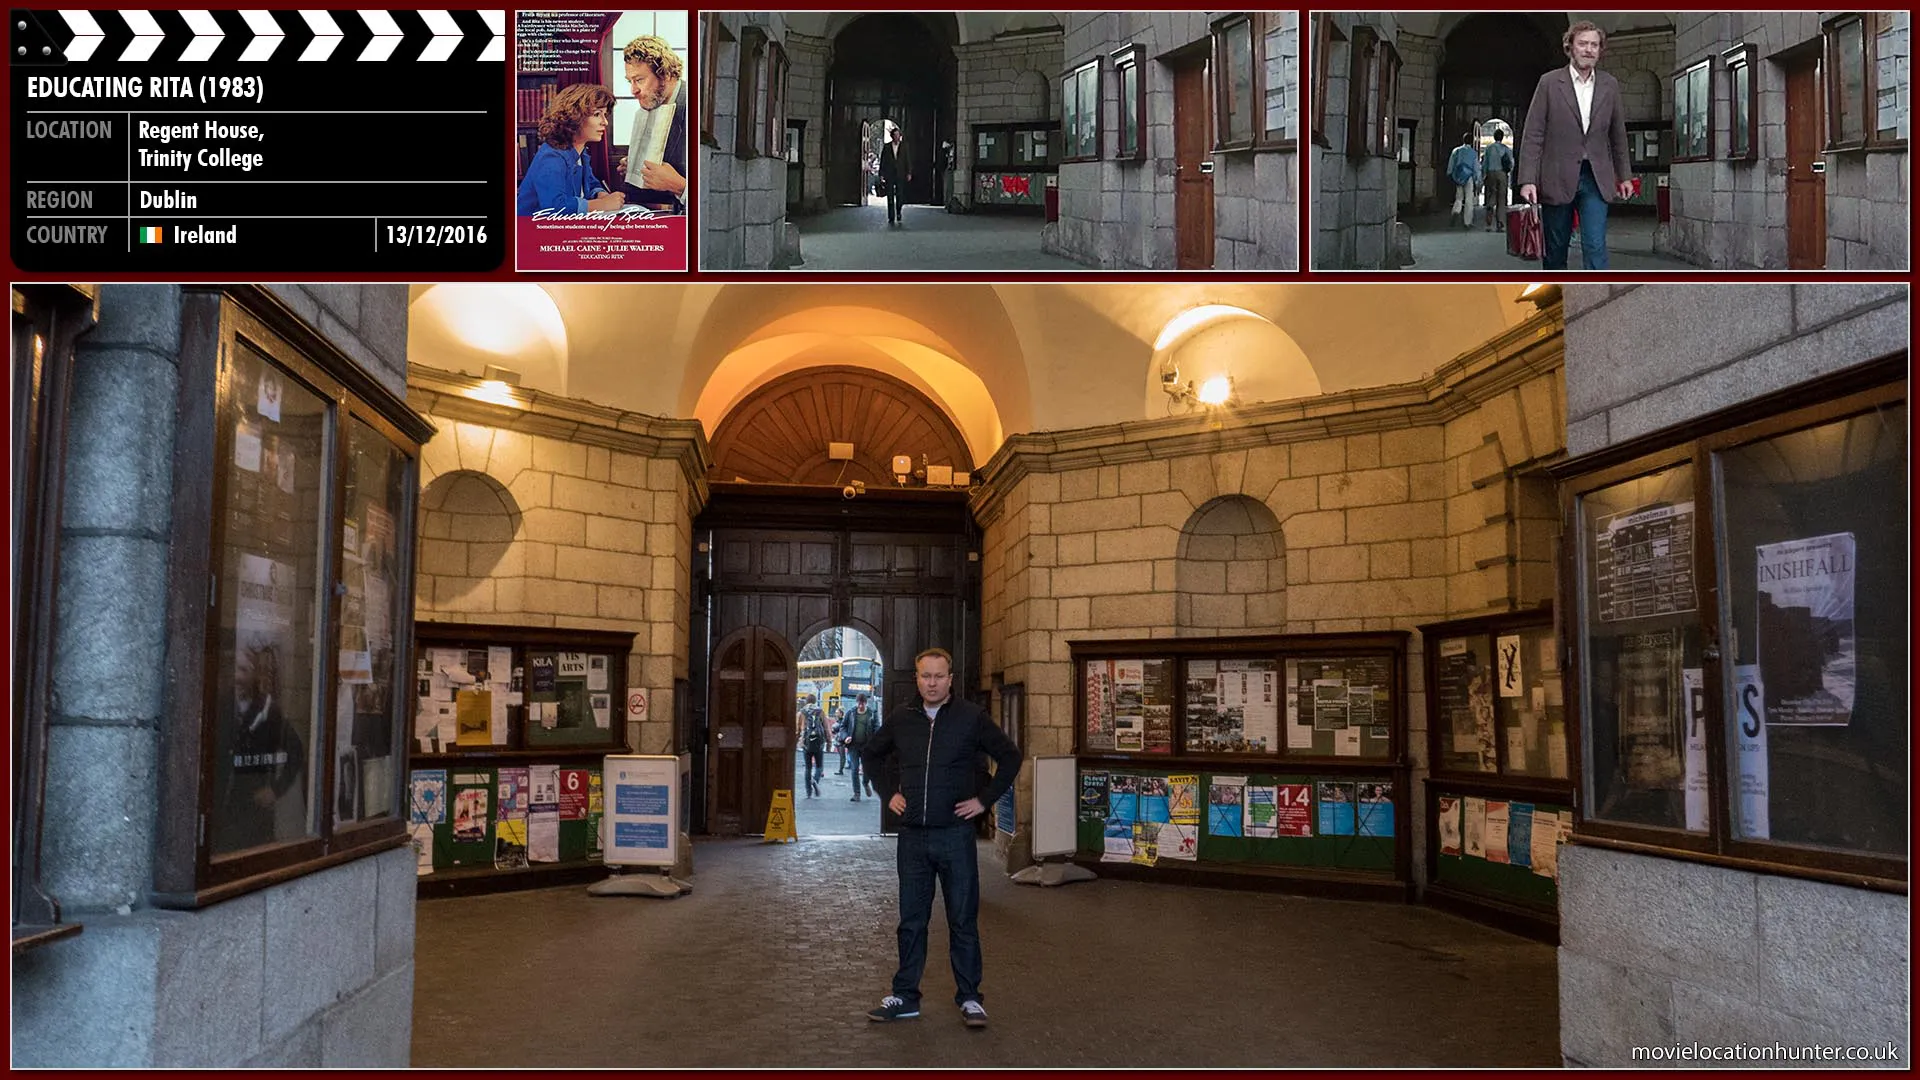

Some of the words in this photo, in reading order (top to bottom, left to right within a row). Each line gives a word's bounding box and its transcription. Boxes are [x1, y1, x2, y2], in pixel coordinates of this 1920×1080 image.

[531, 207, 616, 232] Educating
[618, 206, 672, 224] Rita
[1760, 554, 1852, 583] INISHFALL
[561, 663, 584, 672] ARTS
[568, 772, 579, 790] 6
[1280, 787, 1310, 806] 1.4
